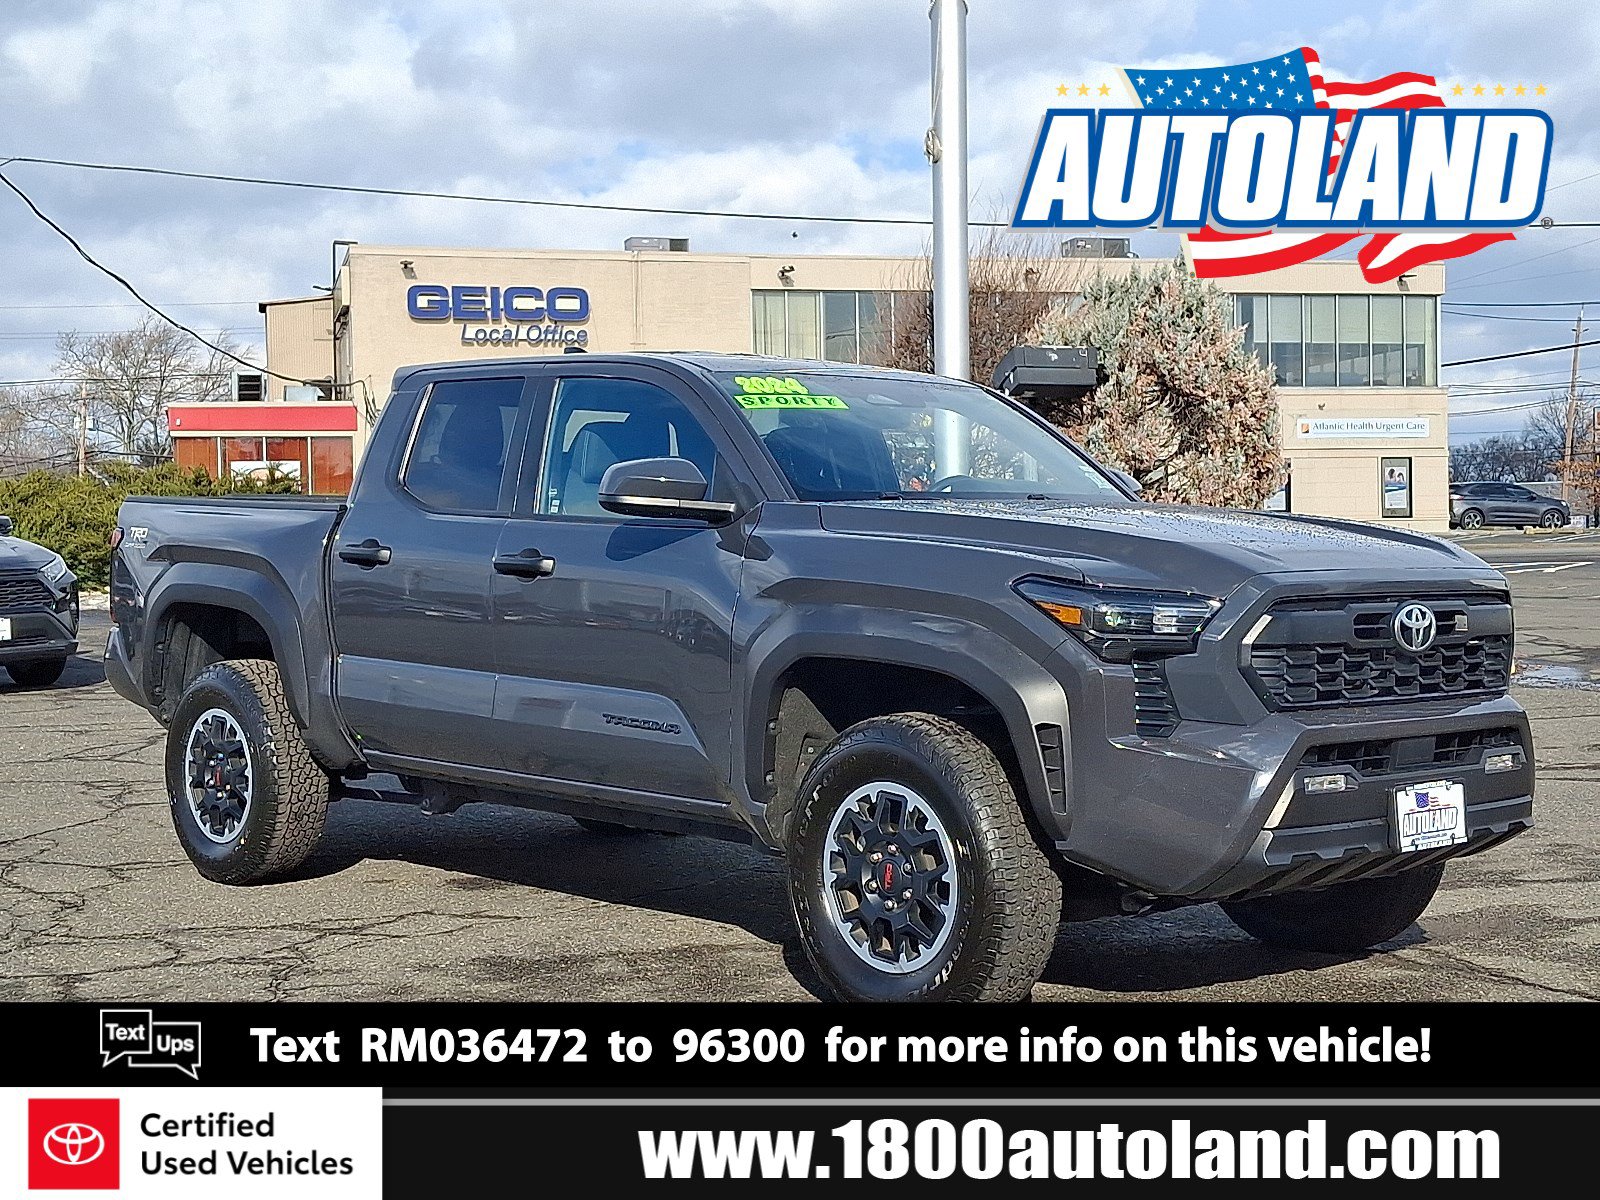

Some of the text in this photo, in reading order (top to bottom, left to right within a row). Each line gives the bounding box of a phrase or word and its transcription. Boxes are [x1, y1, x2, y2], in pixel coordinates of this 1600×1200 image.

[407, 285, 590, 322] GEICO
[461, 323, 589, 344] Local Office
[734, 376, 809, 395] 2024
[741, 396, 837, 406] SPORTY
[1312, 421, 1426, 432] Atlantic Health Urgent Care
[131, 527, 148, 541] TRD
[1403, 807, 1458, 837] AUTOLAND
